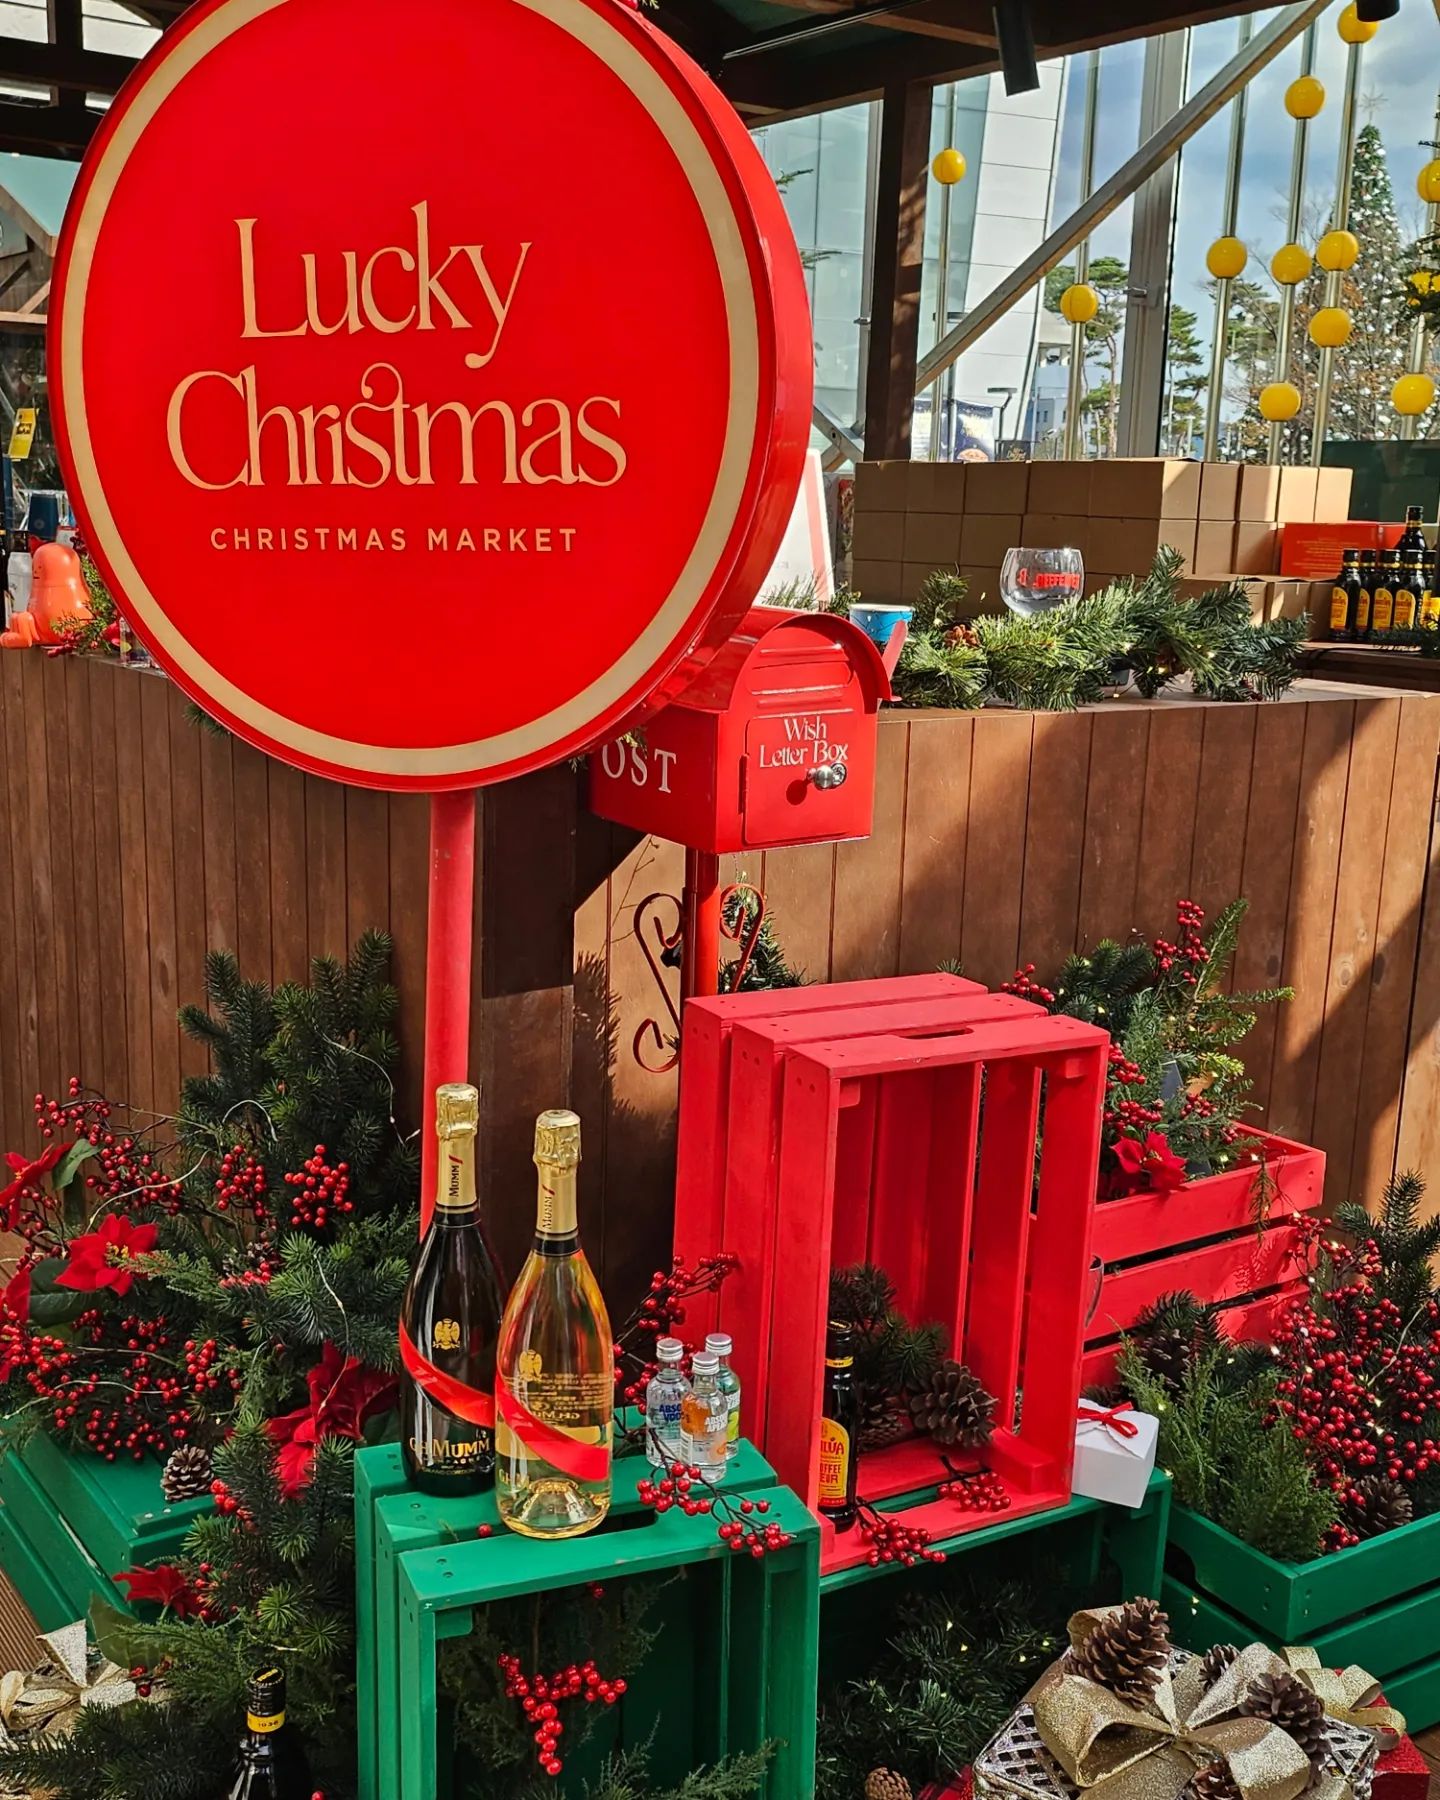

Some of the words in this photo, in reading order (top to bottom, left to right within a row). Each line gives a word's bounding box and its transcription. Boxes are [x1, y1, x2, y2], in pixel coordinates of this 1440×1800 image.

[233, 200, 532, 369] Lucky
[167, 362, 627, 490] Christmas
[210, 527, 407, 551] CHRISTMAS
[427, 528, 577, 552] MARKET
[783, 716, 827, 741] Wish
[601, 737, 677, 794] OST
[760, 745, 808, 768] Letter
[813, 740, 849, 764] Box
[820, 1463, 841, 1474] OFFEE
